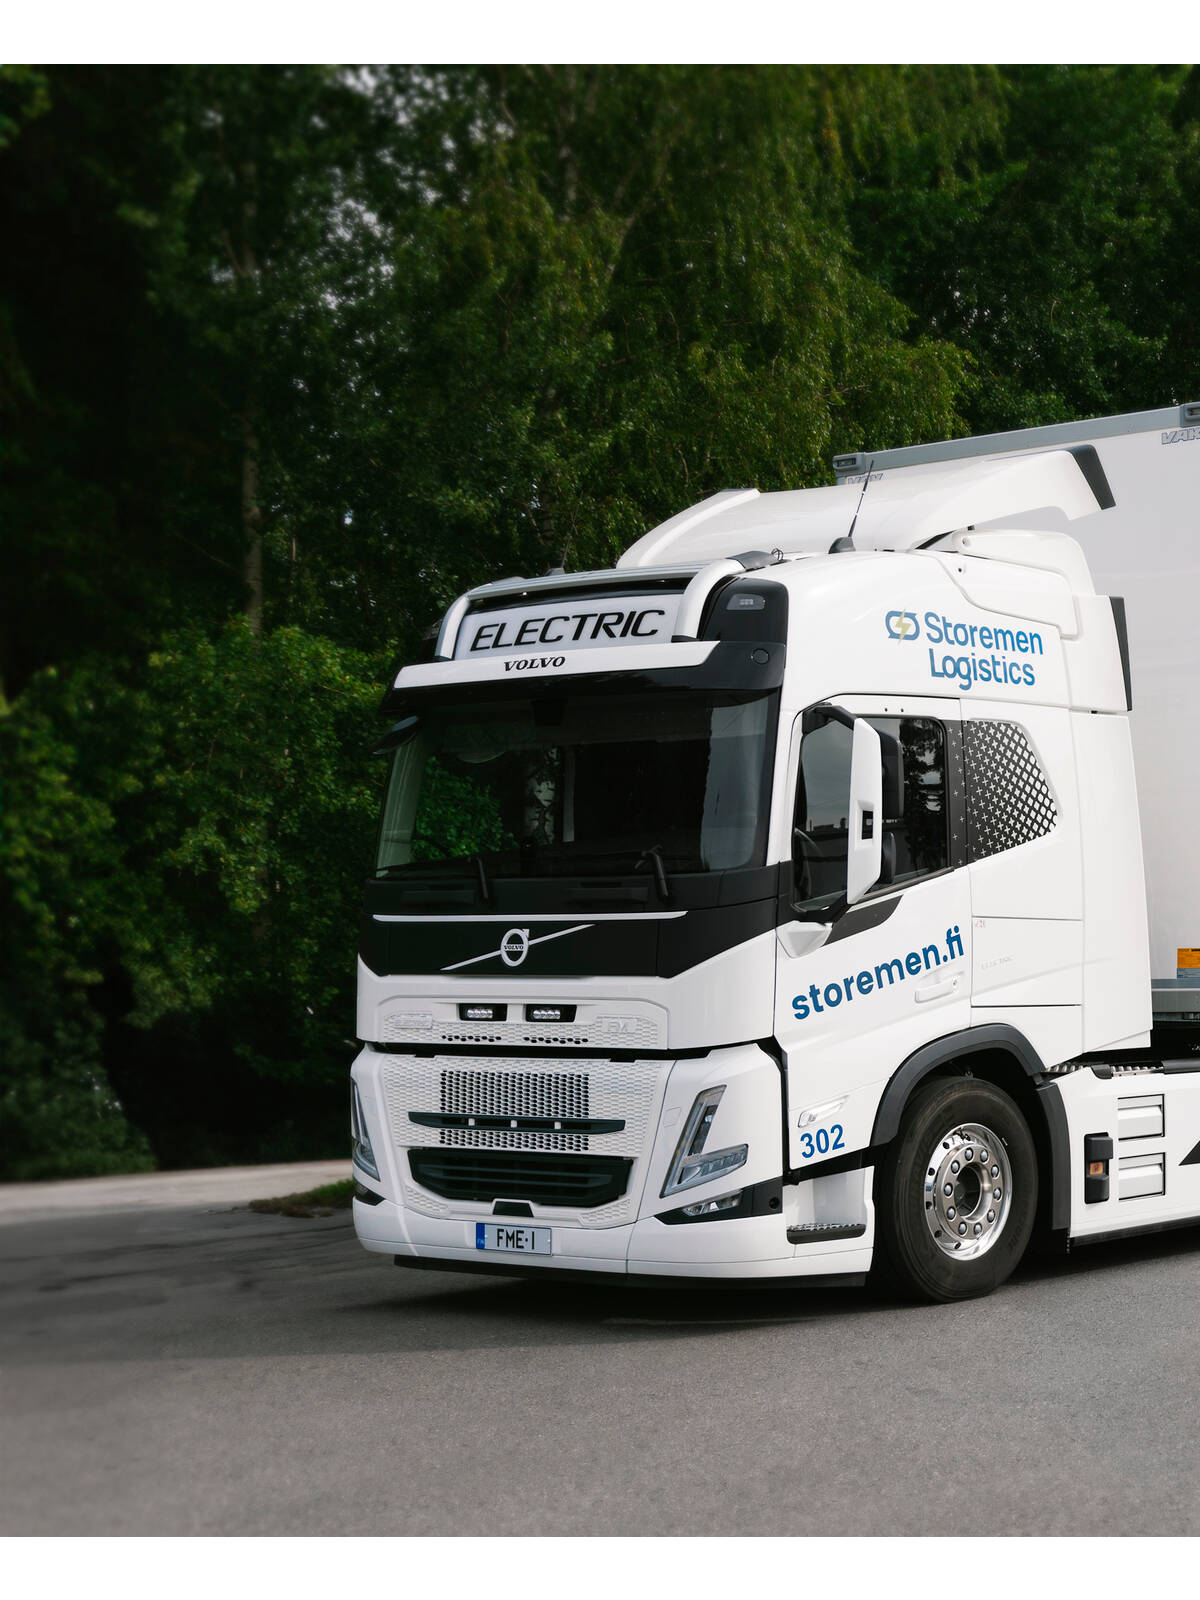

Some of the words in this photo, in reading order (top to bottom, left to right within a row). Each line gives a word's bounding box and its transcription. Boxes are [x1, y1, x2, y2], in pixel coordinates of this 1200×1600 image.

[470, 609, 666, 652] ELECTRIC
[924, 611, 1044, 655] Storemen
[503, 656, 566, 672] VOLVO
[929, 648, 1036, 691] Logistics
[791, 925, 964, 1020] storemen.fi
[800, 1124, 845, 1158] 302
